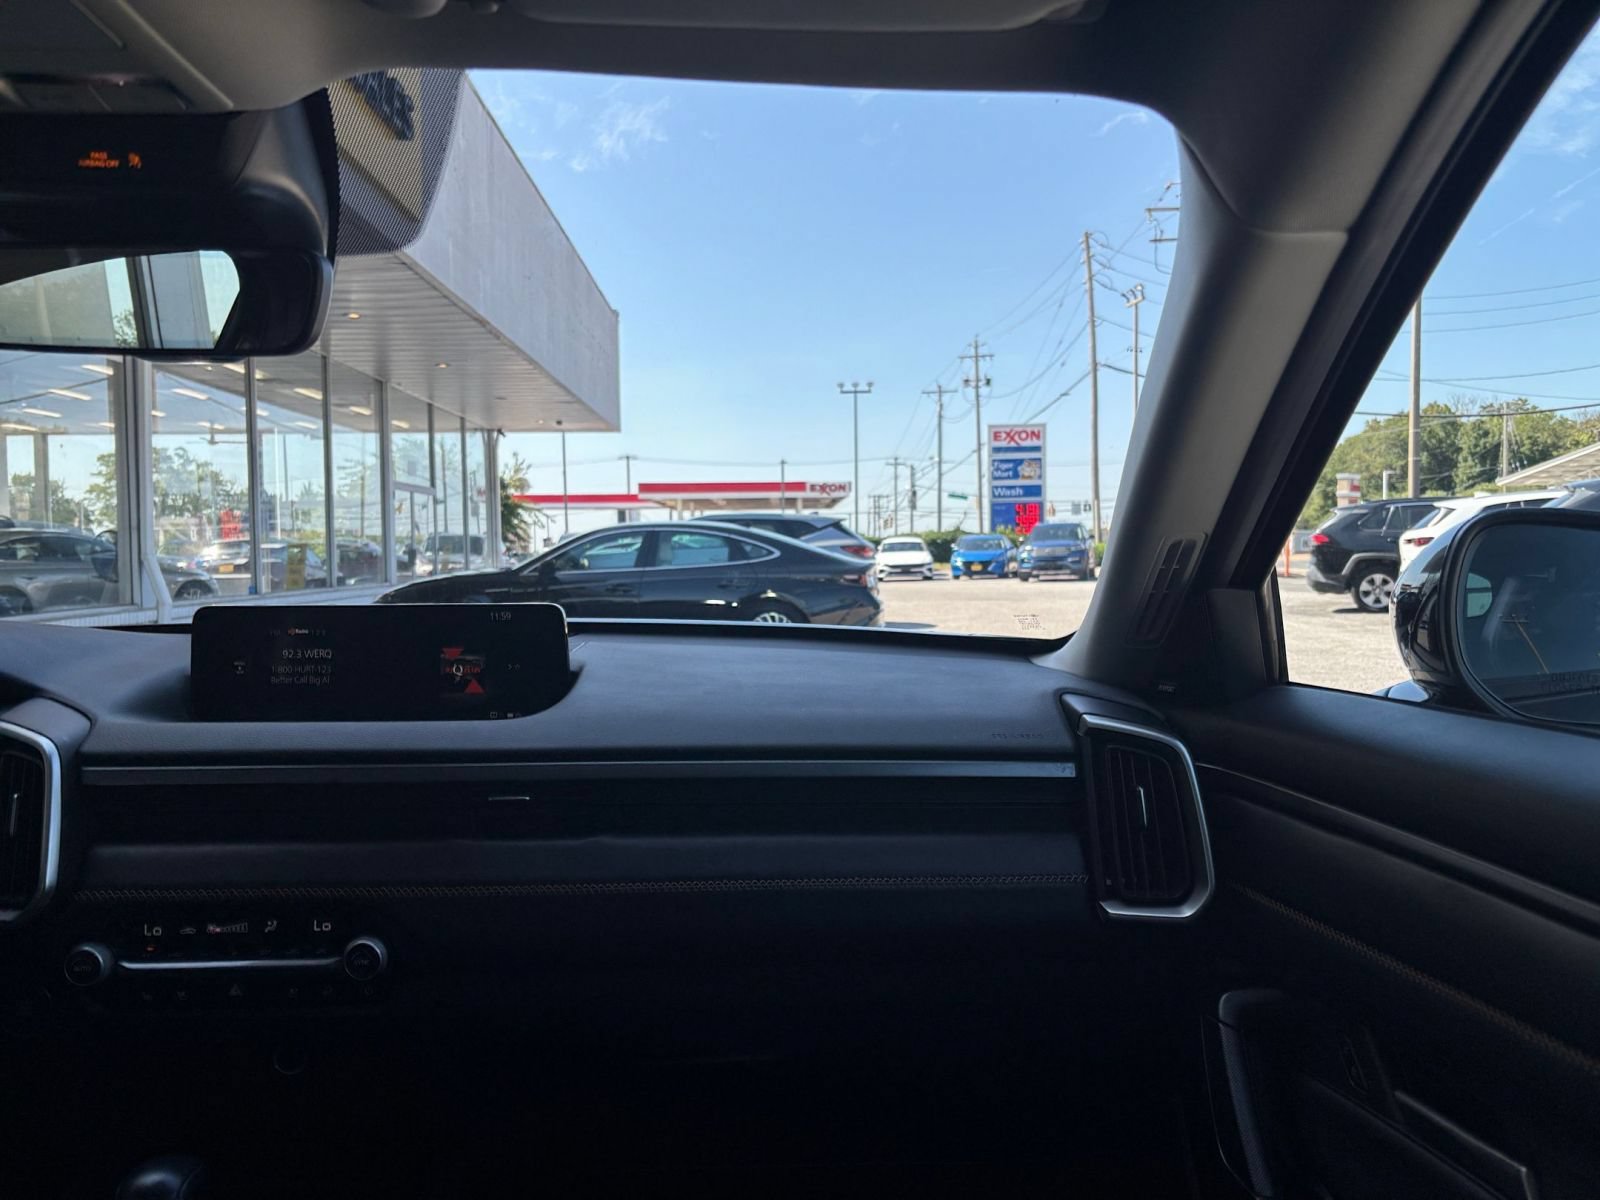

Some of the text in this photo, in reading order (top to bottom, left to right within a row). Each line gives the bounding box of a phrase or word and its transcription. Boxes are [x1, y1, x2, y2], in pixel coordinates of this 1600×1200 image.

[992, 429, 1041, 446] EXXON
[993, 462, 1014, 470] Tiger
[993, 470, 1013, 478] Mart
[809, 483, 846, 496] EXXON
[993, 487, 1023, 496] Wash
[282, 649, 332, 659] 92.3 WERQ
